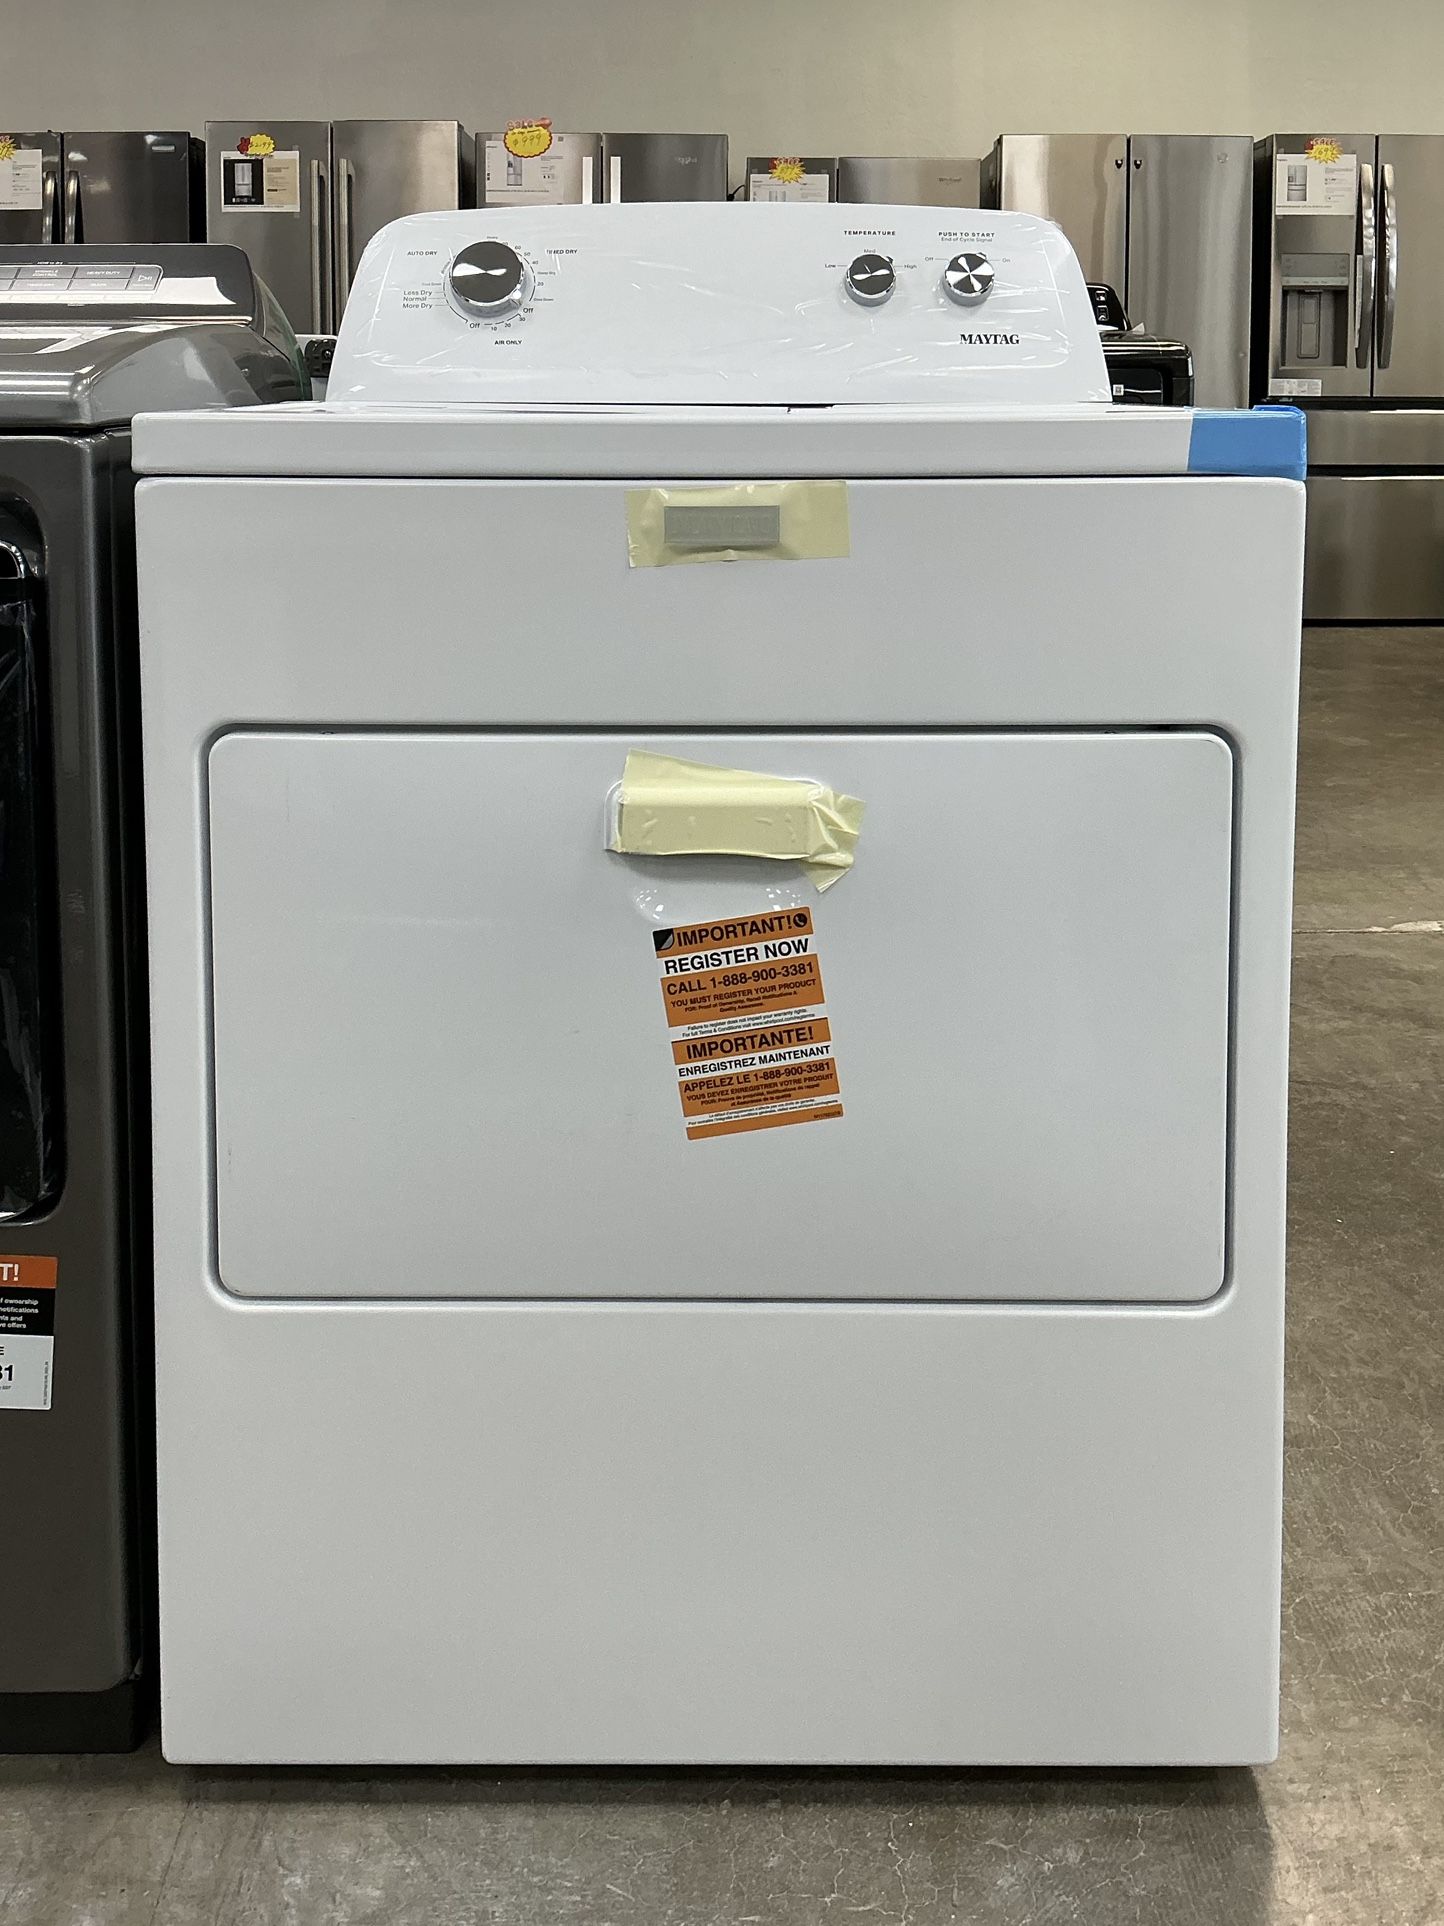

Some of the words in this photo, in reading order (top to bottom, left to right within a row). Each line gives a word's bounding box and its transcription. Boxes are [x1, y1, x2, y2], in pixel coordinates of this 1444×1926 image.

[960, 333, 1020, 345] MAYTAG
[677, 915, 792, 947] IMPORTANT!
[664, 947, 759, 975] REGISTER
[764, 938, 809, 959] NOW
[667, 979, 707, 995] CALL
[710, 961, 813, 988] 1-888-900-3381
[671, 999, 688, 1007] YOU
[690, 995, 711, 1004] MUST
[713, 989, 752, 1001] REGISTER
[754, 985, 777, 994] YOUR
[778, 979, 816, 991] PRODUCT
[686, 1026, 814, 1059] IMPORTANTE!
[678, 1057, 756, 1077] ENREGISTREZ
[758, 1045, 830, 1065] MAINTENANT
[684, 1077, 734, 1093] APPELEZ
[736, 1073, 751, 1085] LE
[753, 1061, 830, 1082] 1-888-900-3381
[687, 1093, 706, 1101] VOUS
[707, 1089, 729, 1098] DEVEZ
[730, 1082, 778, 1094] ENREGISTRER
[780, 1078, 802, 1087] VOTRE
[804, 1073, 833, 1083] PRODUIT
